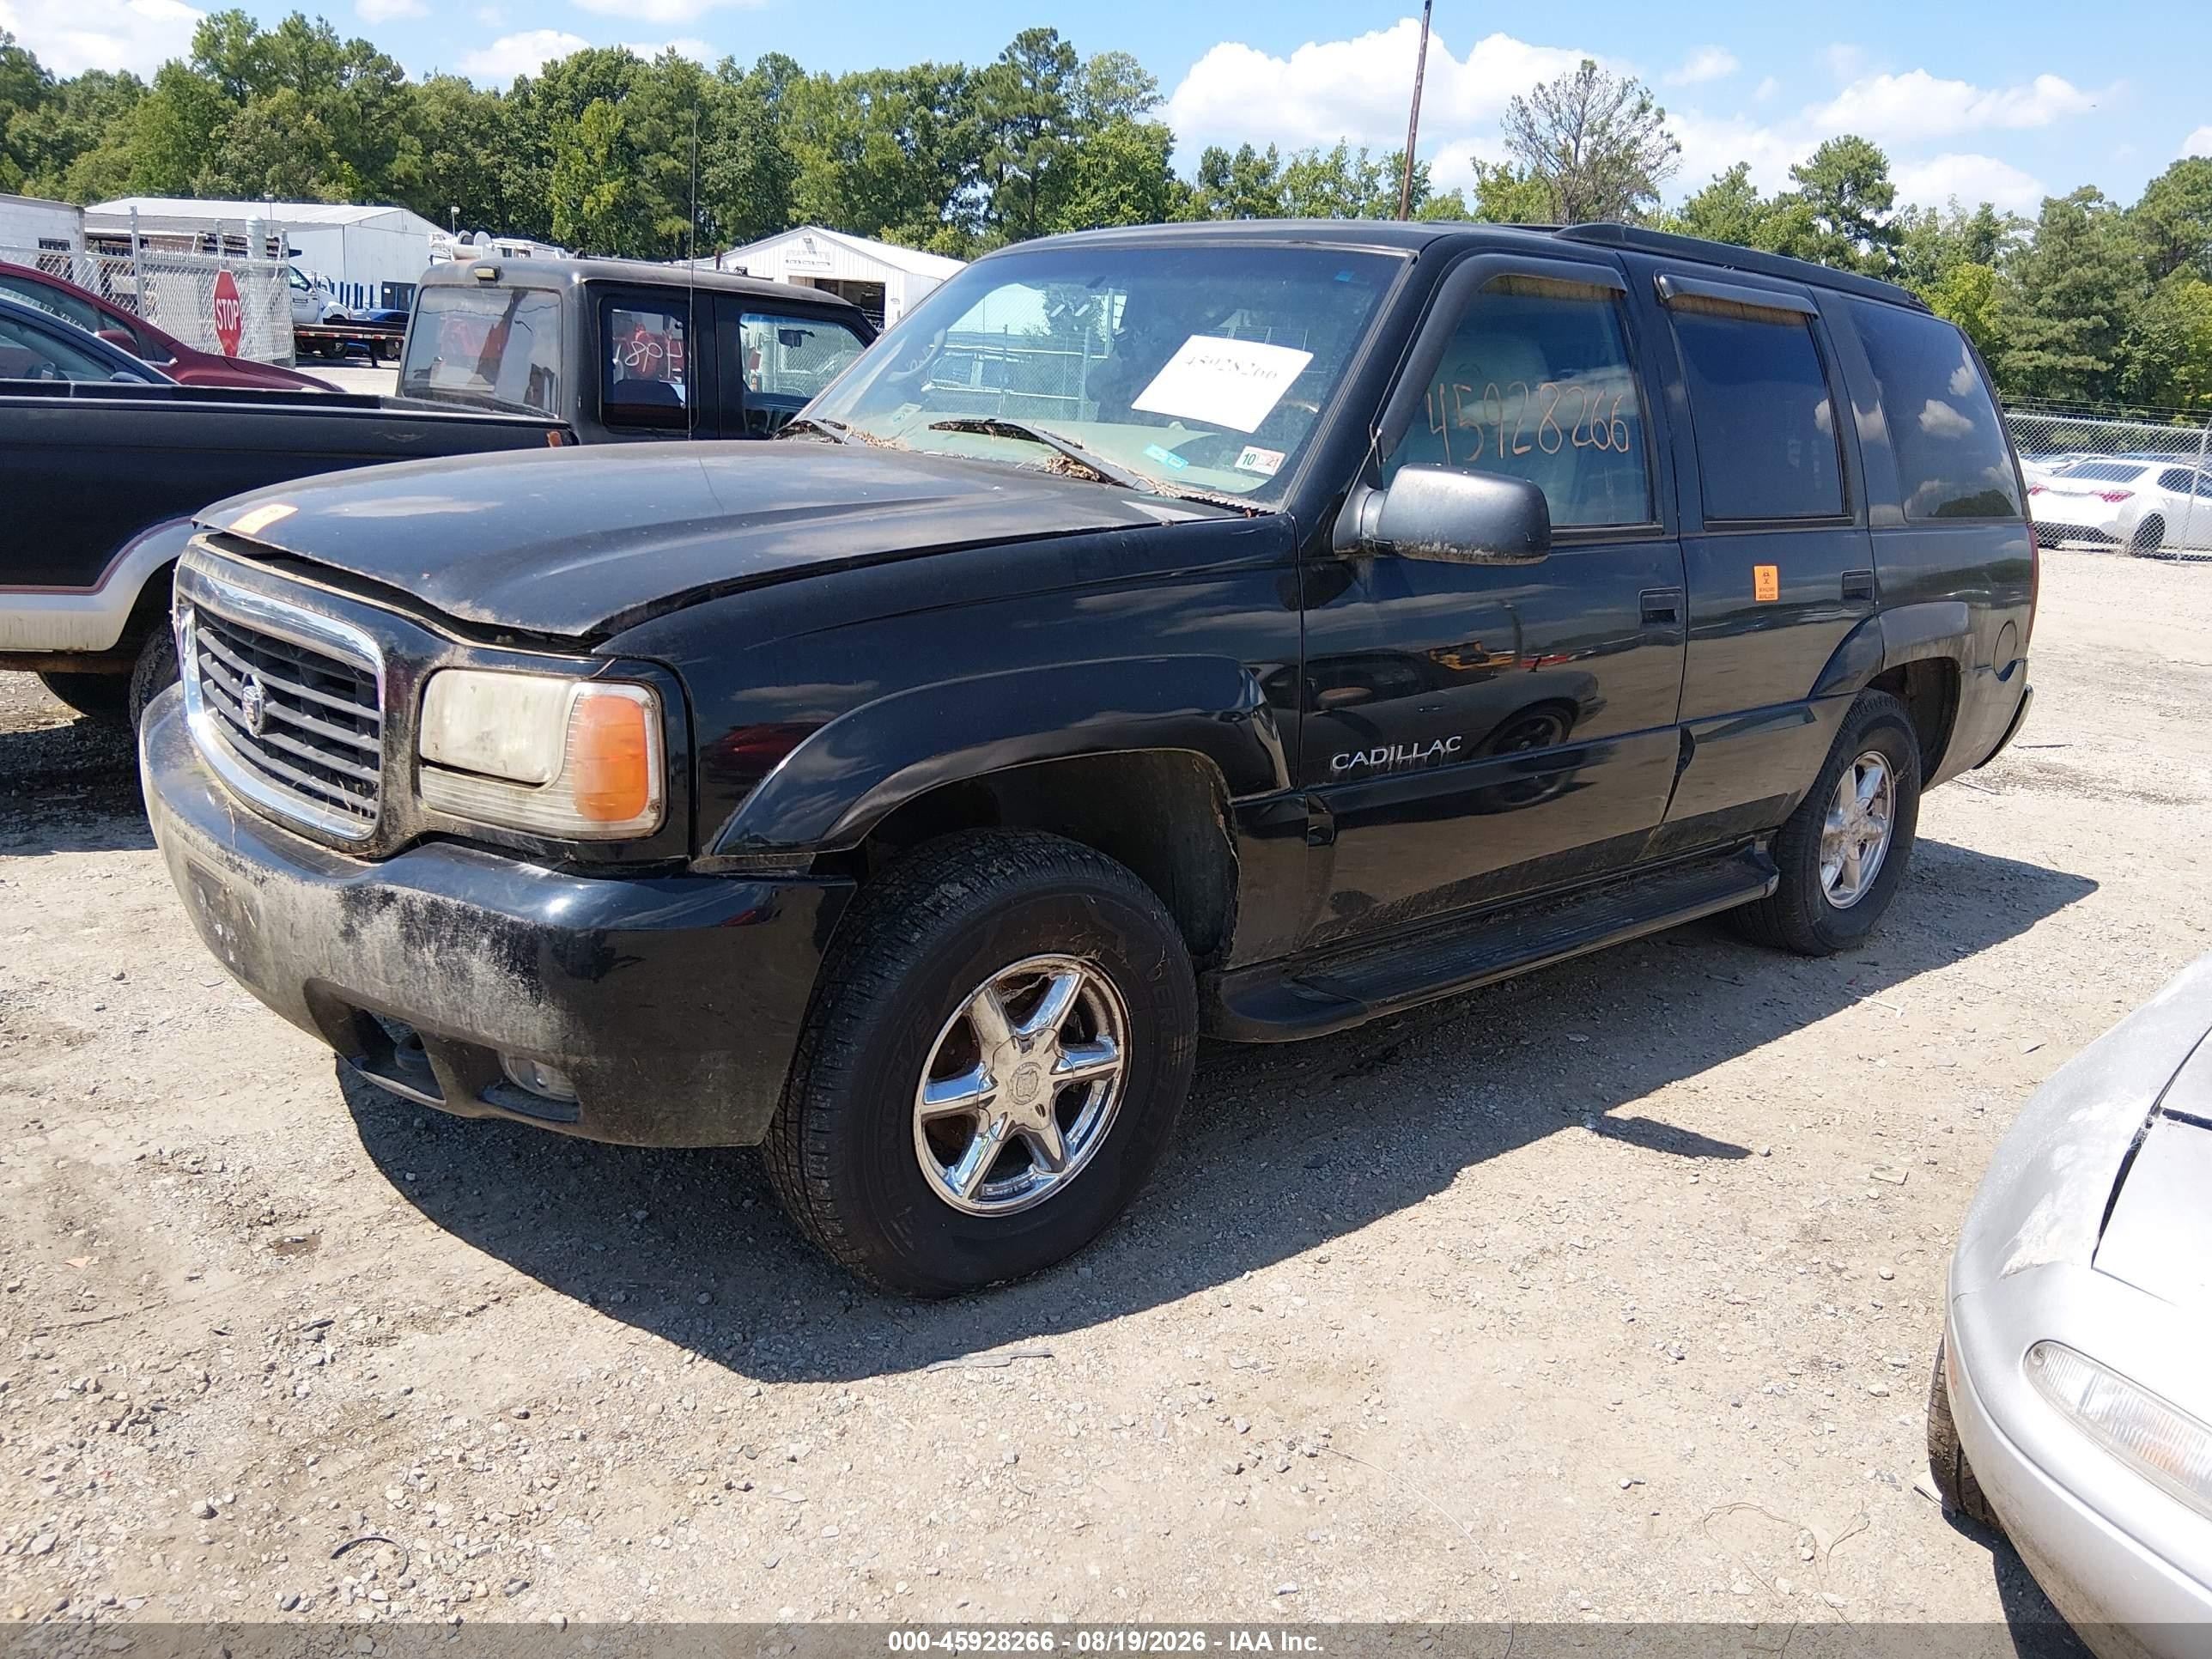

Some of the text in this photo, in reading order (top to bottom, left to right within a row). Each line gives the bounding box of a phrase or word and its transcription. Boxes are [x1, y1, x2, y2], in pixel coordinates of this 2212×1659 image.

[216, 298, 240, 331] STOP
[1427, 381, 1630, 465] 45928266
[1242, 453, 1257, 466] 10
[1331, 735, 1462, 770] CADILLAC
